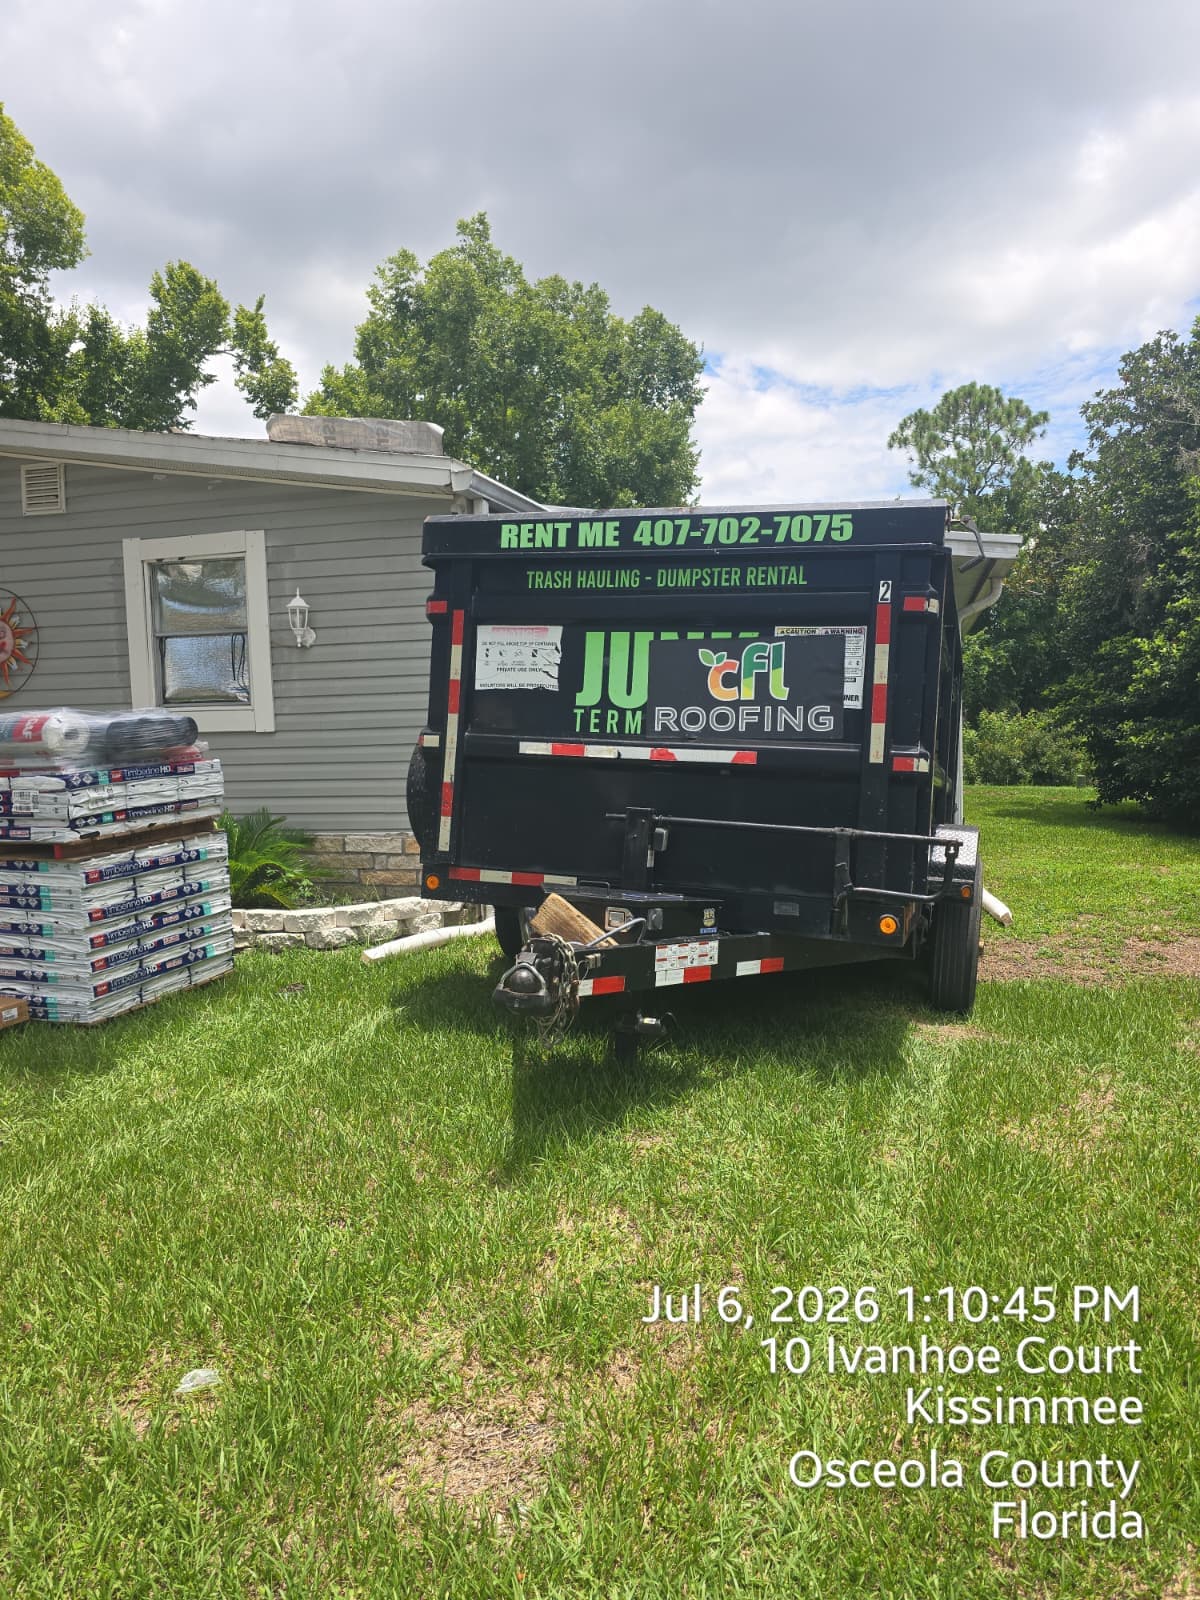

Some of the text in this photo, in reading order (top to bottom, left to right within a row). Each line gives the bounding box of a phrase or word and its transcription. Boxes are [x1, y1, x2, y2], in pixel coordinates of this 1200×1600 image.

[500, 513, 853, 548] RENT ME 407-702-7075
[526, 570, 572, 588] TRASH
[577, 569, 640, 588] HAULING
[657, 567, 740, 587] DUMPSTER
[746, 565, 808, 585] RENTAL
[880, 581, 891, 601] 2
[654, 705, 834, 731] ROOFING
